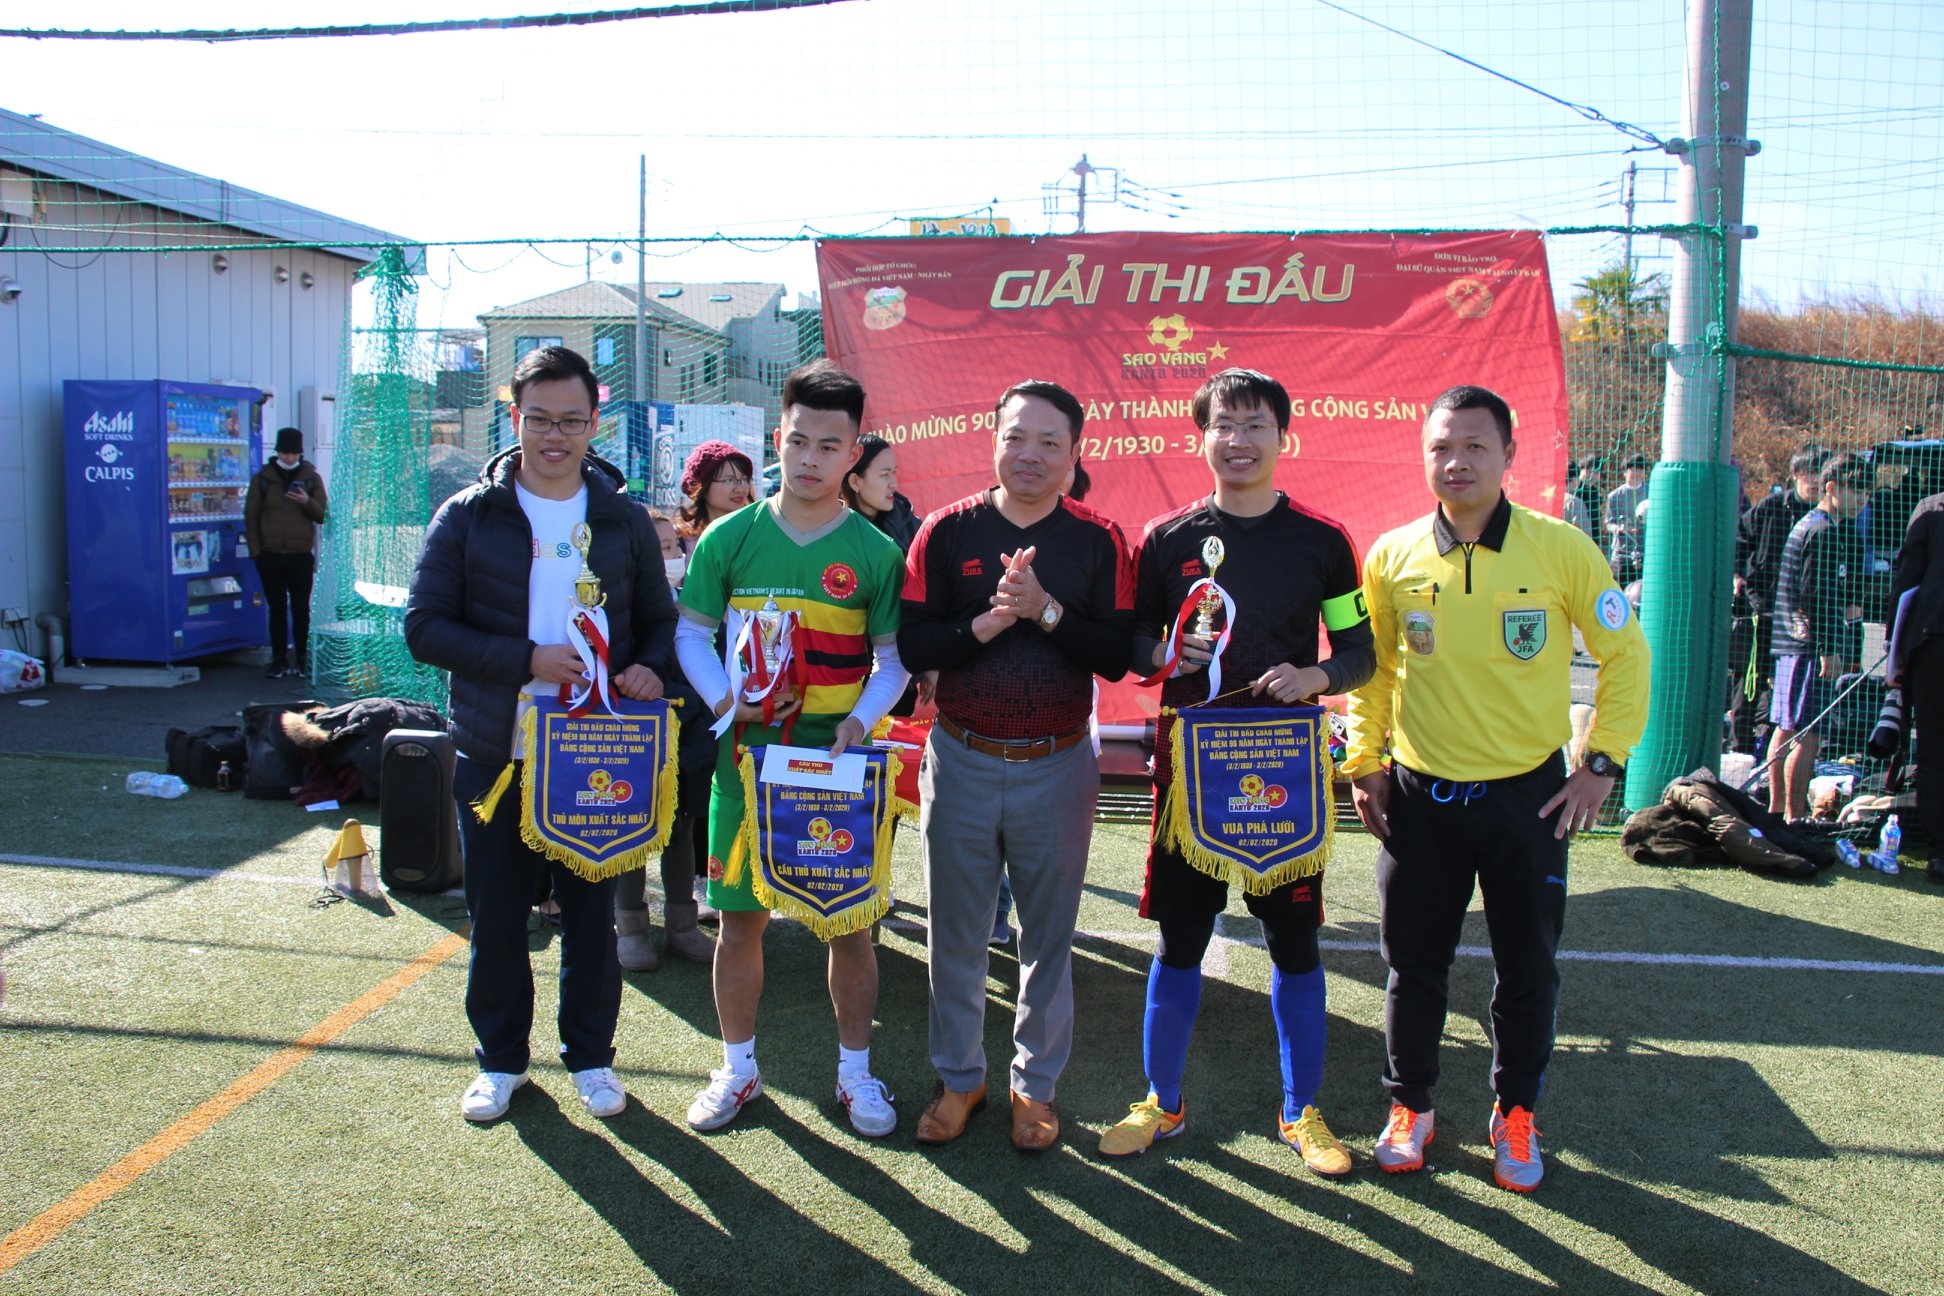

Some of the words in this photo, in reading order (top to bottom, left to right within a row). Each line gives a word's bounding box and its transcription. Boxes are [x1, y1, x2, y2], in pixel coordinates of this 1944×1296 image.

[990, 254, 1104, 308] GIẢI
[1122, 263, 1211, 303] THI
[1226, 252, 1354, 304] ĐẤU
[1122, 353, 1156, 366] SAO
[1122, 367, 1167, 380] KANTO
[1172, 366, 1206, 378] 2020
[84, 411, 133, 433] Asahi
[911, 415, 966, 440] MỪNG
[1120, 396, 1192, 419] THÀNH
[1311, 396, 1368, 421] CỘNG
[1374, 397, 1416, 421] SẢN
[85, 466, 134, 482] CALPIS
[1508, 614, 1542, 622] REFEREE
[629, 745, 644, 753] NAM
[1230, 750, 1248, 761] CỘNG
[1266, 748, 1281, 760] VIỆT
[1283, 749, 1299, 757] NAM
[552, 812, 566, 824] THỦ
[568, 813, 586, 825] MÔN
[589, 812, 610, 824] XUẤT
[628, 811, 648, 824] NHẤT
[580, 829, 618, 837] 02/02/2020
[1222, 822, 1244, 834] VUA
[1247, 820, 1268, 834] PHÁ
[1271, 820, 1295, 834] LƯỚI
[1239, 838, 1278, 846] 02/02/2020
[794, 864, 808, 876] THỦ
[812, 864, 832, 878] XUẤT
[835, 864, 850, 878] SẮC
[852, 864, 872, 878] NHẤT
[807, 882, 844, 891] 02/02/2020
